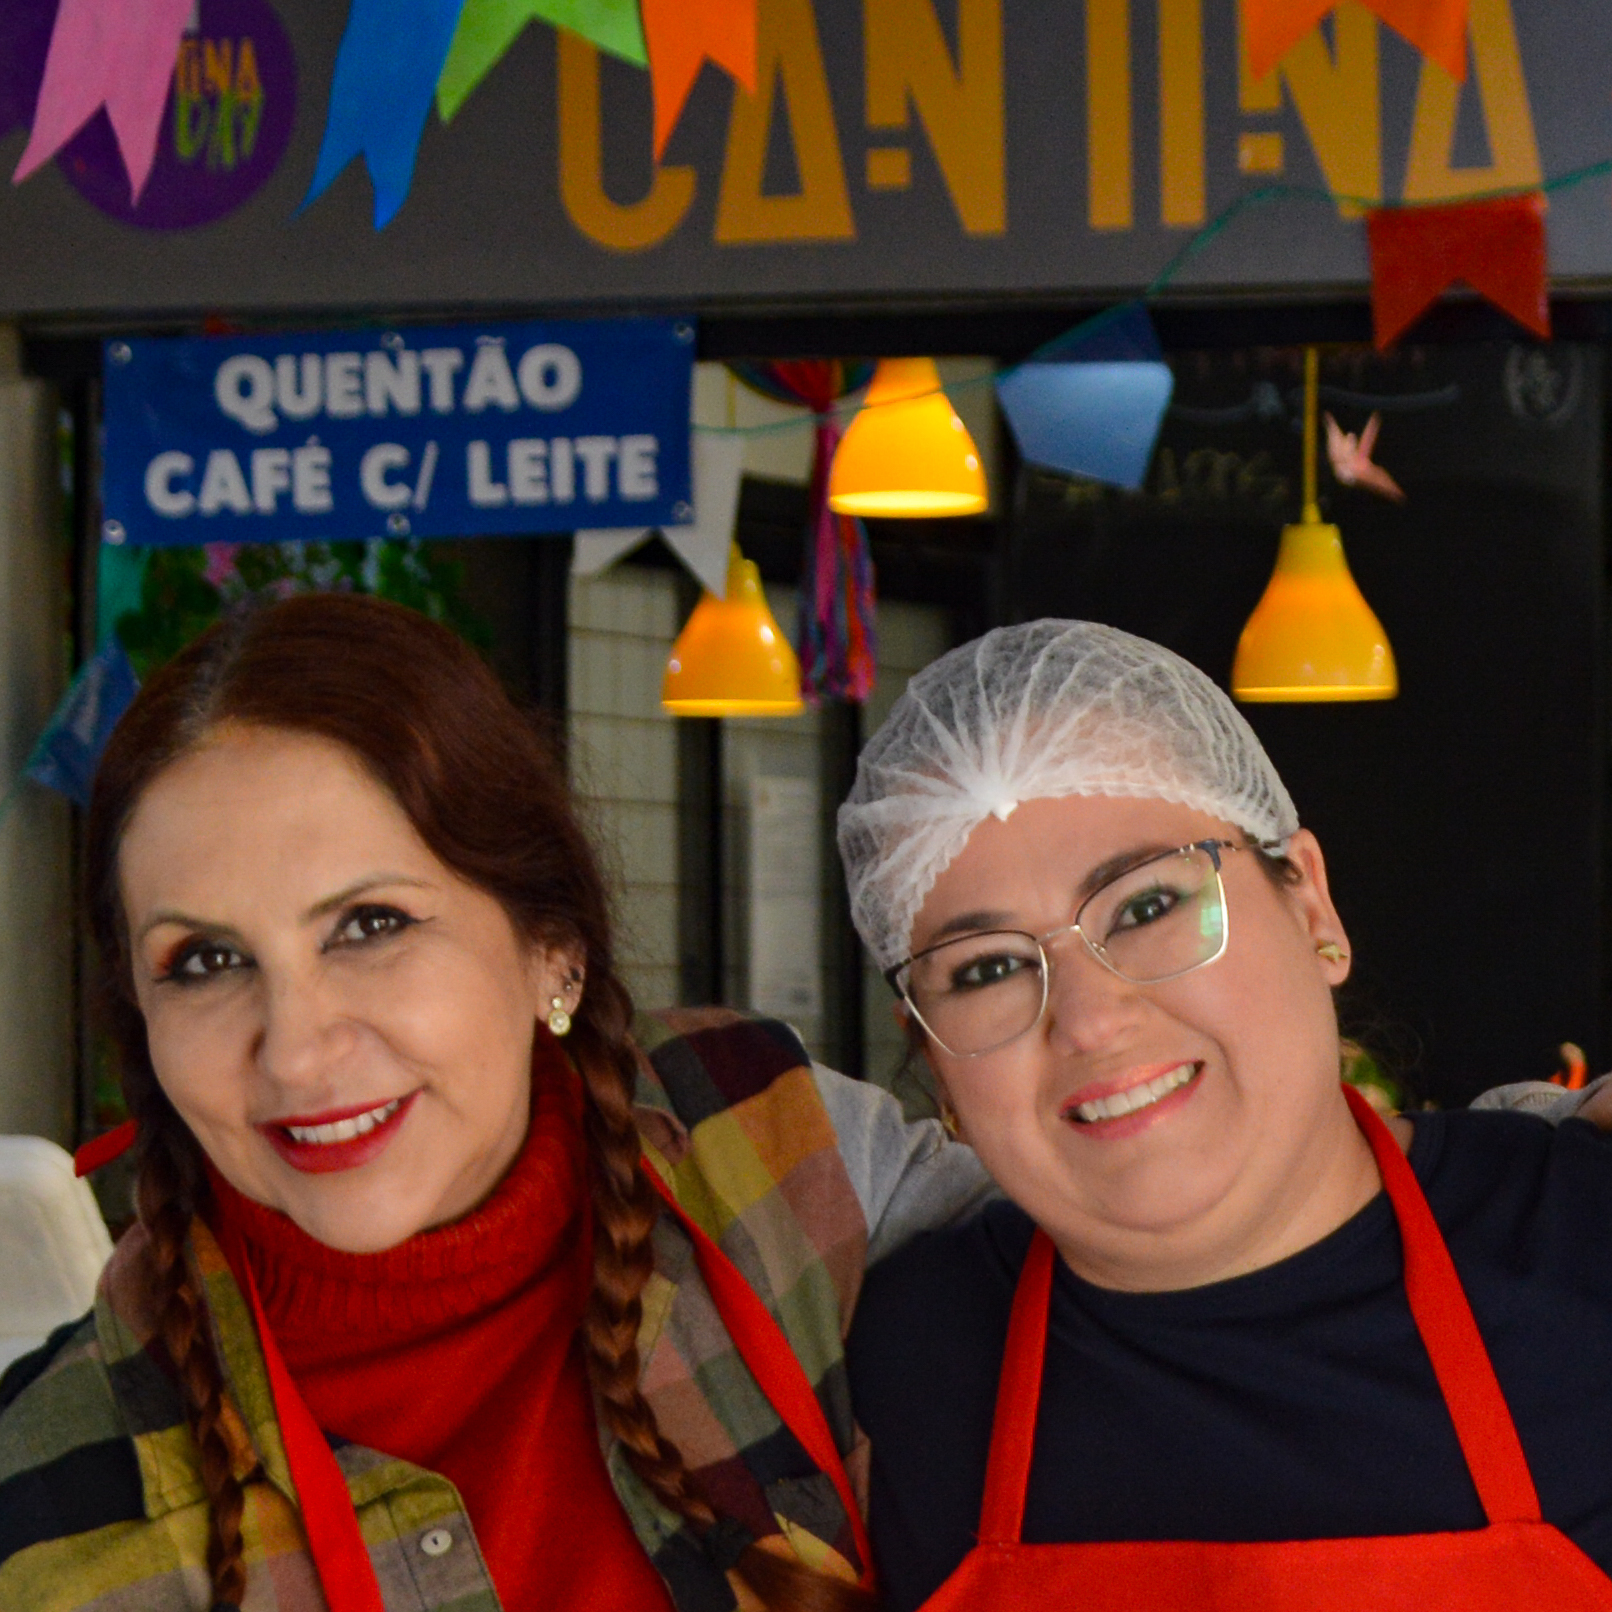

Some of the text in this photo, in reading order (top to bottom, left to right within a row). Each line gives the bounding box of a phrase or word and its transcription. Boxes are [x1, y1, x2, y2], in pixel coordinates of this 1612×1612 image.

[214, 336, 583, 433] QUENTÃO
[143, 434, 660, 518] CAFÉ C/ LEITE
